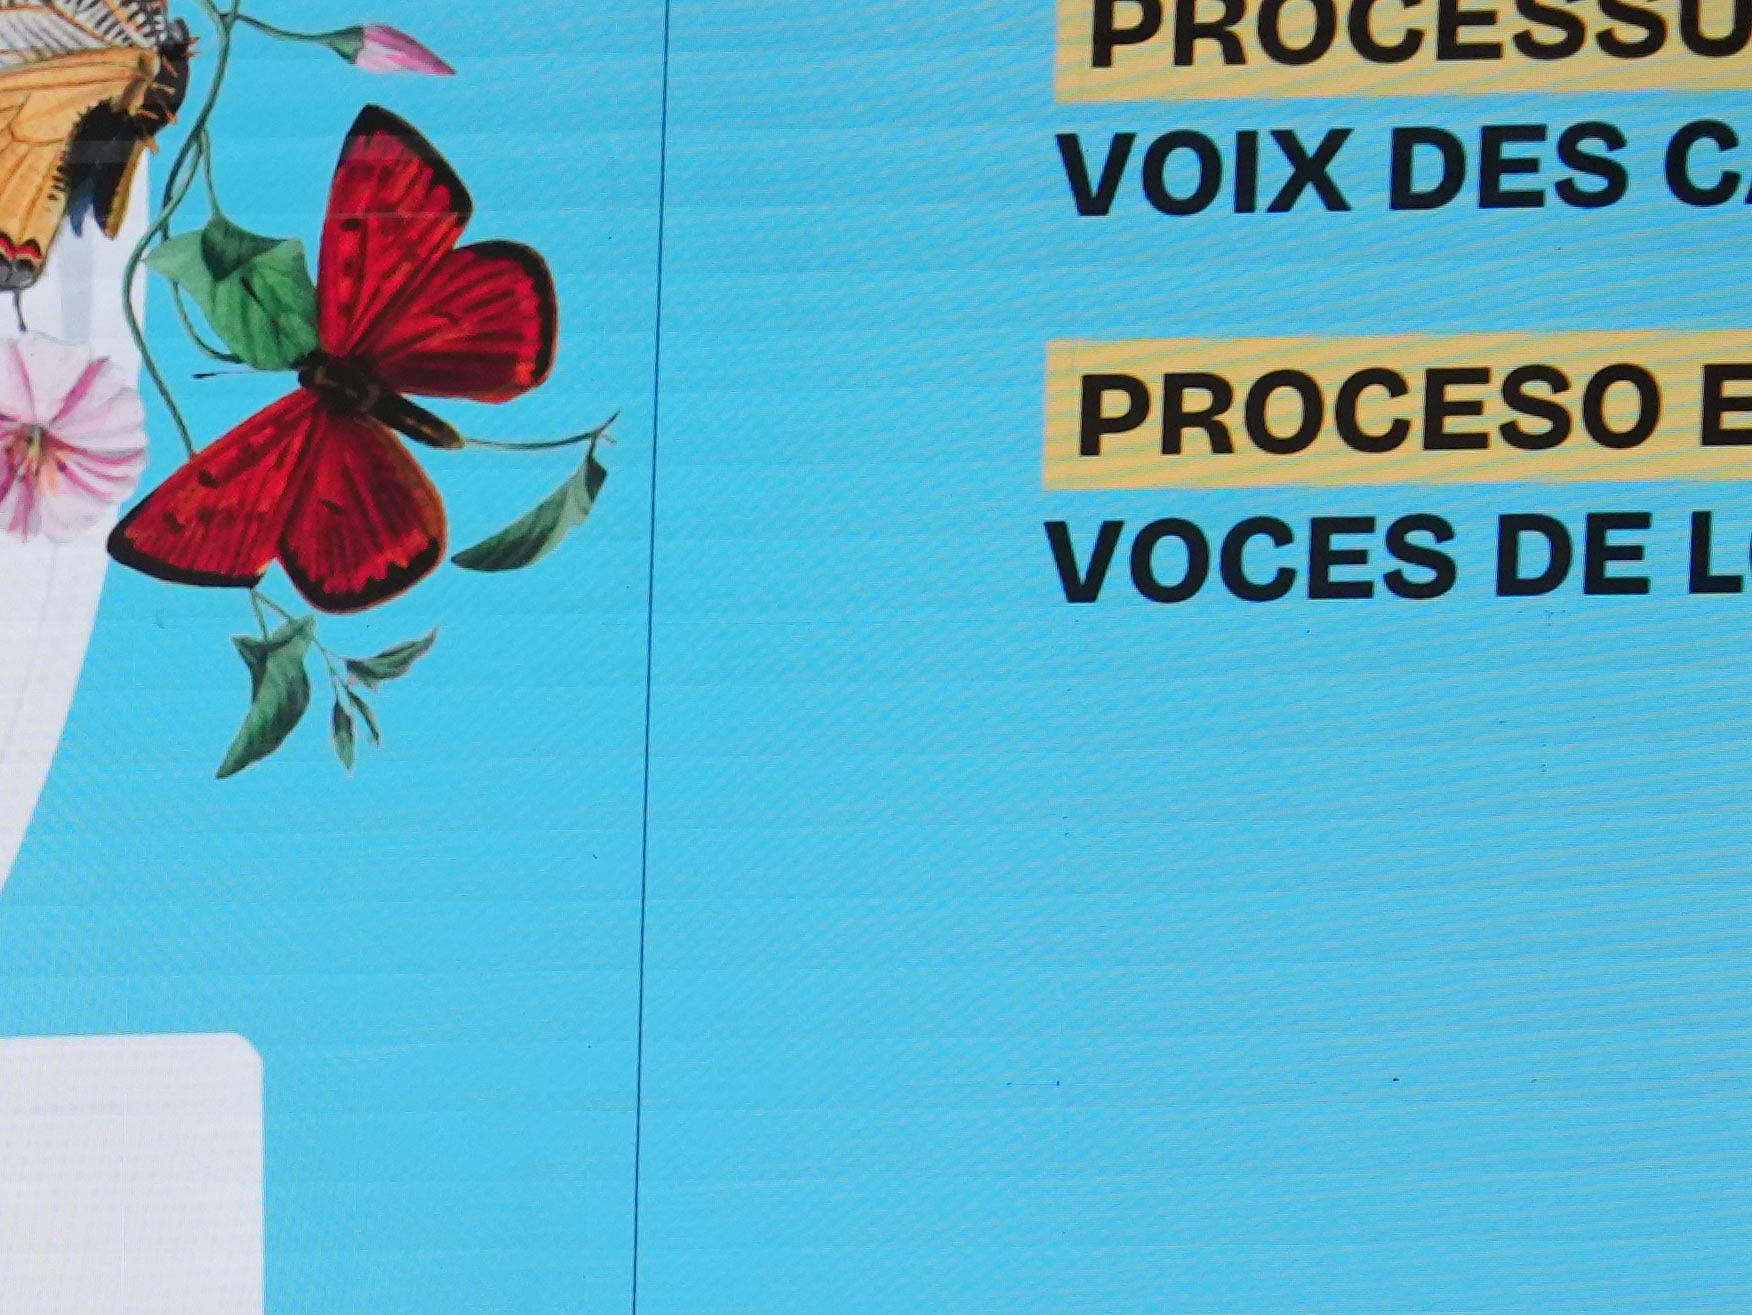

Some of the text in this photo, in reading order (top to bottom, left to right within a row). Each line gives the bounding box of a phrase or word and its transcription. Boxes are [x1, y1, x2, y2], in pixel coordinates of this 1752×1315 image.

[1055, 118, 1752, 217] VOIX DES C
[1078, 362, 1663, 456] PROCESO
[1043, 509, 1752, 604] VOCES DE L
